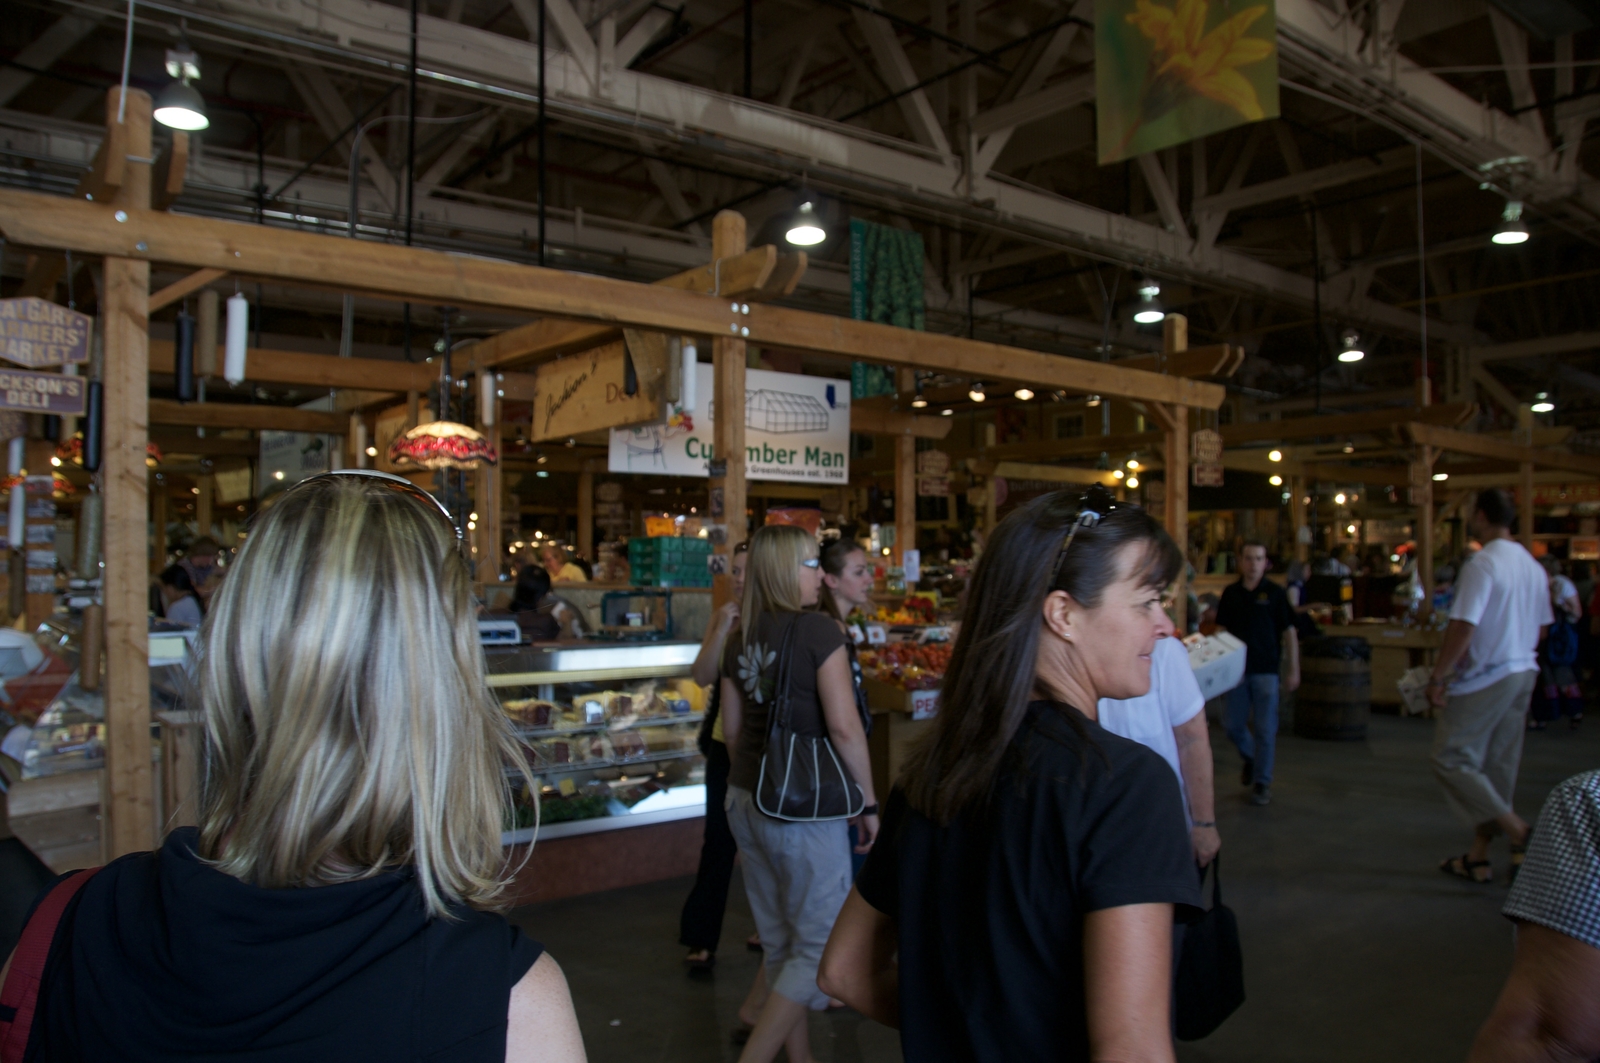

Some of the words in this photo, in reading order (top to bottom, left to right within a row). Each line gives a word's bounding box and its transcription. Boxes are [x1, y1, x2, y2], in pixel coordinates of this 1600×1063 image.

[852, 232, 862, 283] MARKET
[6, 390, 50, 409] DELI
[804, 446, 845, 468] Man
[751, 465, 805, 477] Greenhouses
